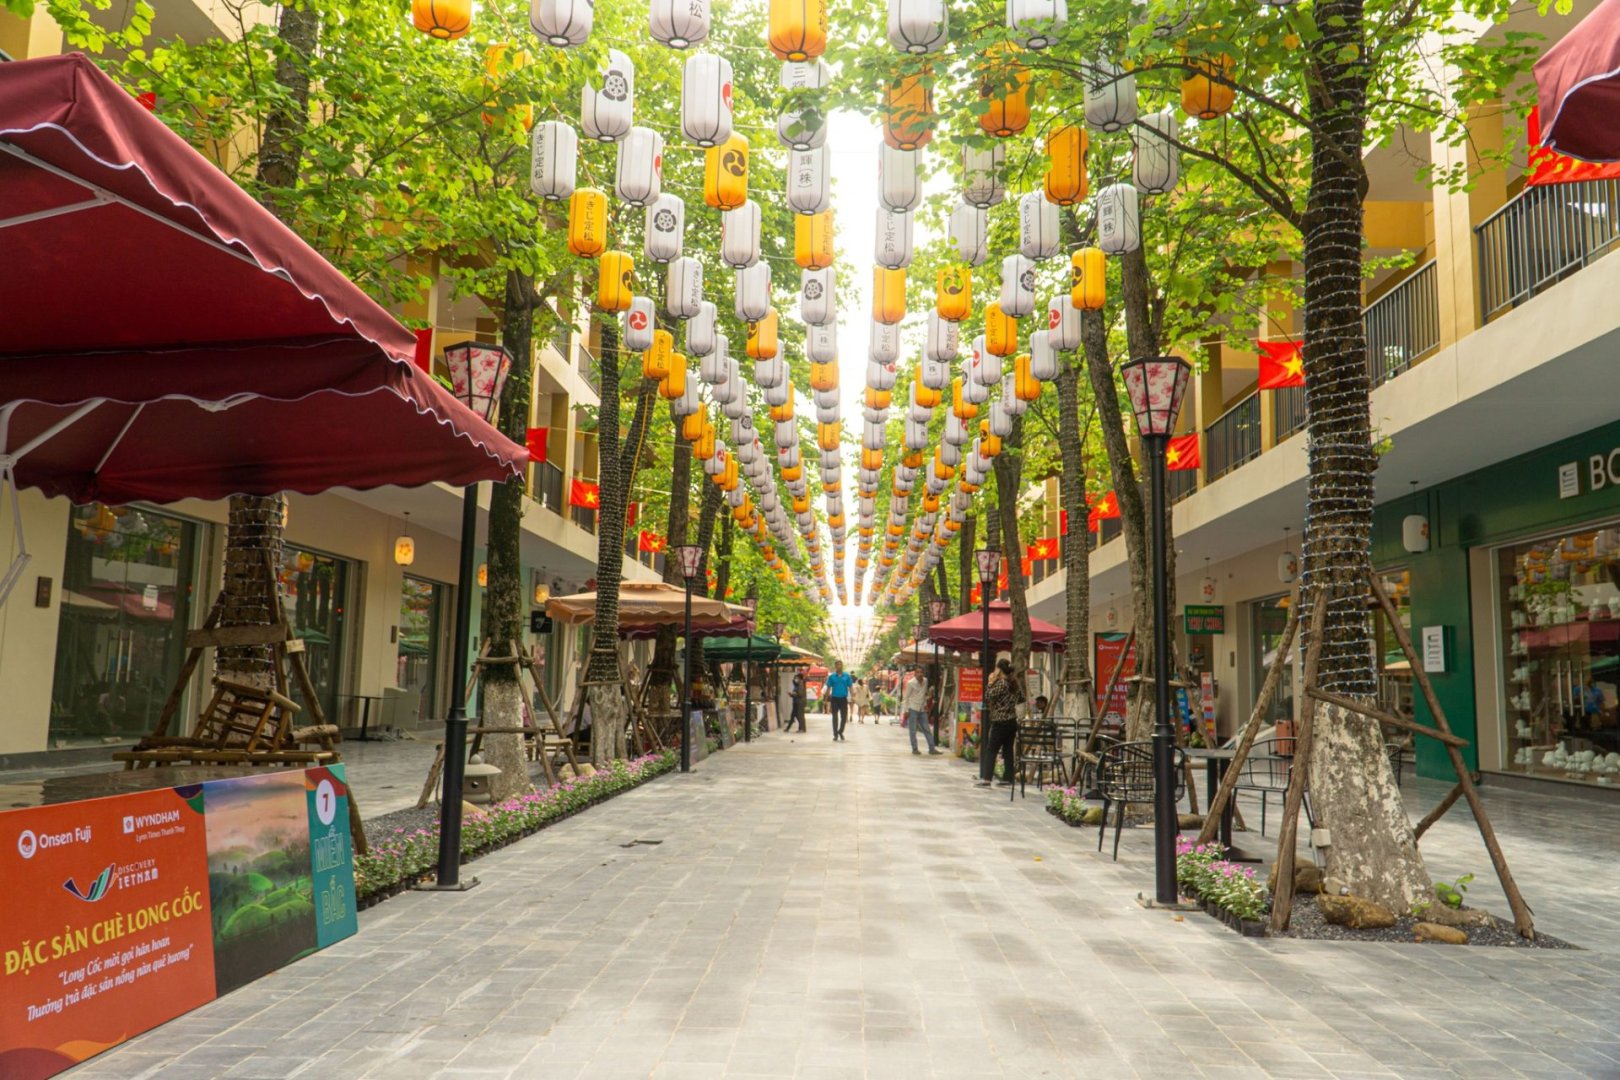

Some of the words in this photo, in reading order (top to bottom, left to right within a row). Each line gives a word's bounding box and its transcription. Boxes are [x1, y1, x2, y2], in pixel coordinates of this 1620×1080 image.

[584, 192, 596, 241] つきじ定松
[135, 809, 180, 829] WYNDHAM
[39, 832, 73, 849] Onsen
[75, 825, 92, 843] Fuji
[118, 858, 156, 875] DISCOVERY
[5, 940, 49, 976] ĐẶC
[52, 925, 89, 960] SẢN
[91, 912, 125, 945] CHÈ
[127, 902, 170, 934] LONG
[172, 886, 203, 918] CỐC
[65, 988, 80, 1007] trà
